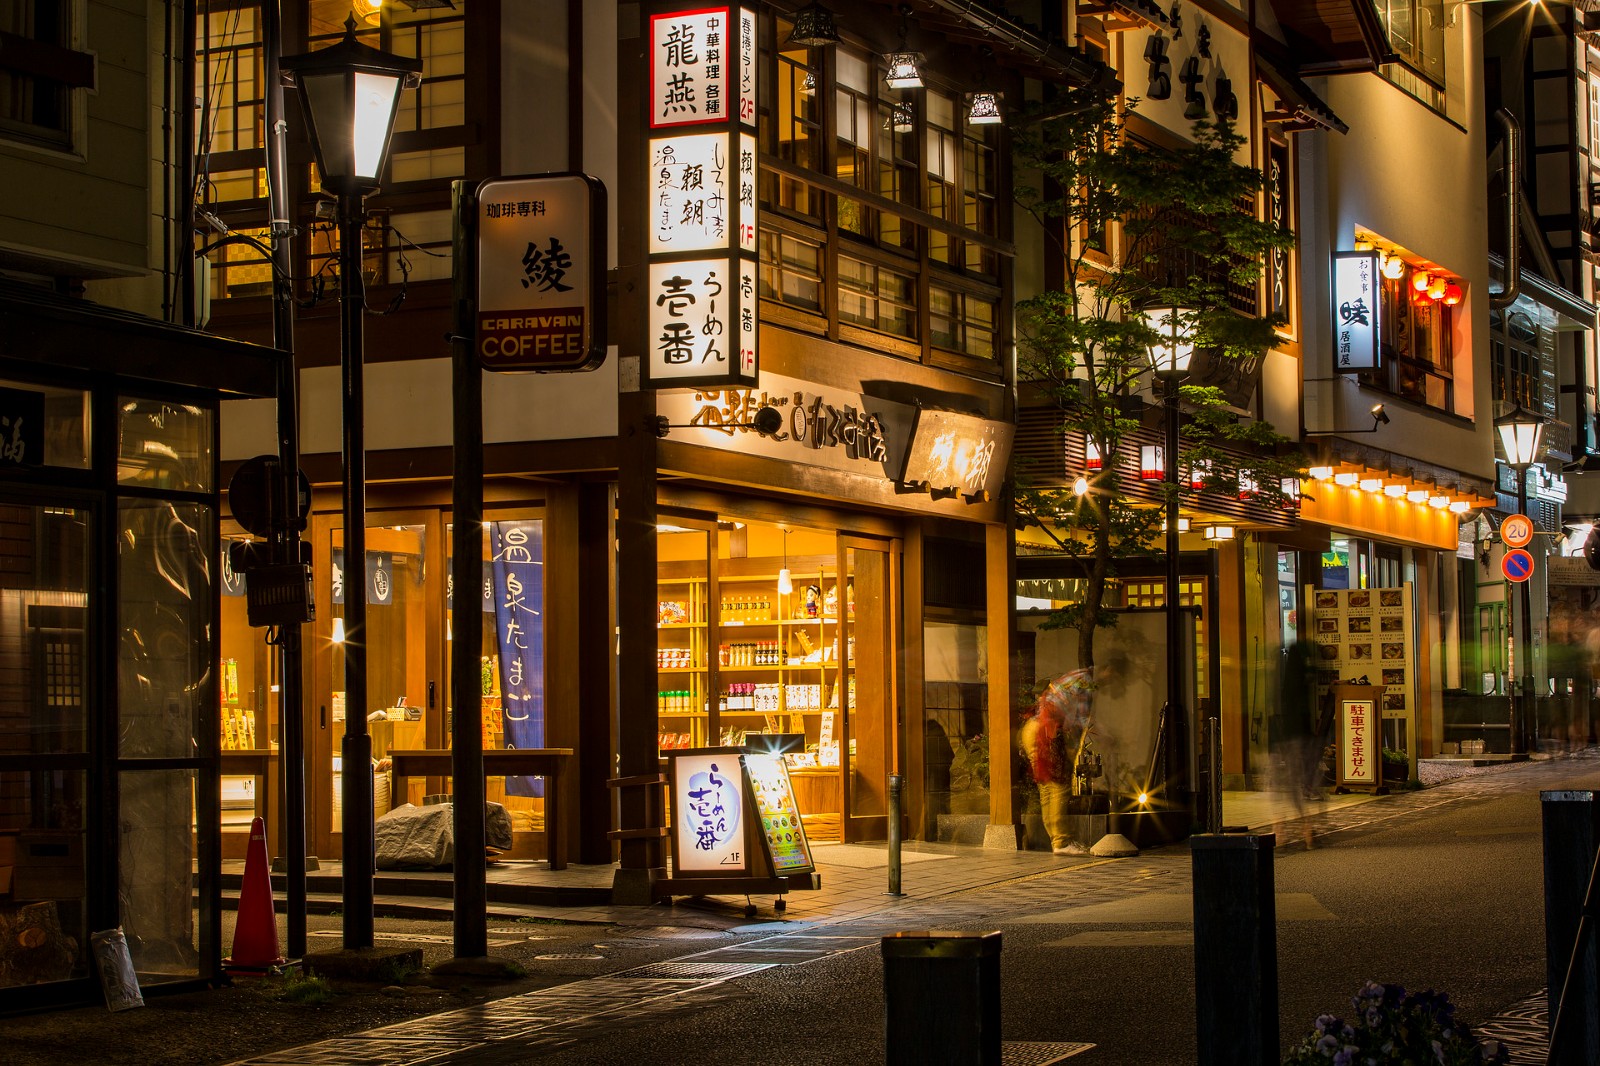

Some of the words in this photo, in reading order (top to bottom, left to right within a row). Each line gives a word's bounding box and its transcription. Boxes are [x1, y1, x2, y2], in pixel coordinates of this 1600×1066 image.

[661, 23, 699, 118] 龍燕
[705, 17, 720, 115] 中華料理各種
[740, 97, 754, 120] 2F
[486, 200, 546, 219] 珈琲専科
[653, 144, 688, 243] 温泉たまご
[680, 163, 704, 226] 頼朝
[740, 223, 754, 245] 1F
[520, 237, 575, 293] 綾
[1358, 259, 1369, 295] お食事
[482, 314, 582, 331] CARAVAN
[656, 275, 696, 365] 壱番
[701, 271, 726, 364] らーめん
[740, 275, 753, 332] 壱番
[481, 333, 581, 358] COFFEE
[740, 348, 754, 371] 1F
[1339, 331, 1351, 366] 居酒屋
[1508, 524, 1527, 539] 20
[492, 528, 543, 721] 温泉たまご
[1350, 704, 1365, 777] 駐車できません
[687, 787, 722, 851] 壱番
[709, 763, 728, 833] らーめん
[731, 852, 740, 862] 1F
